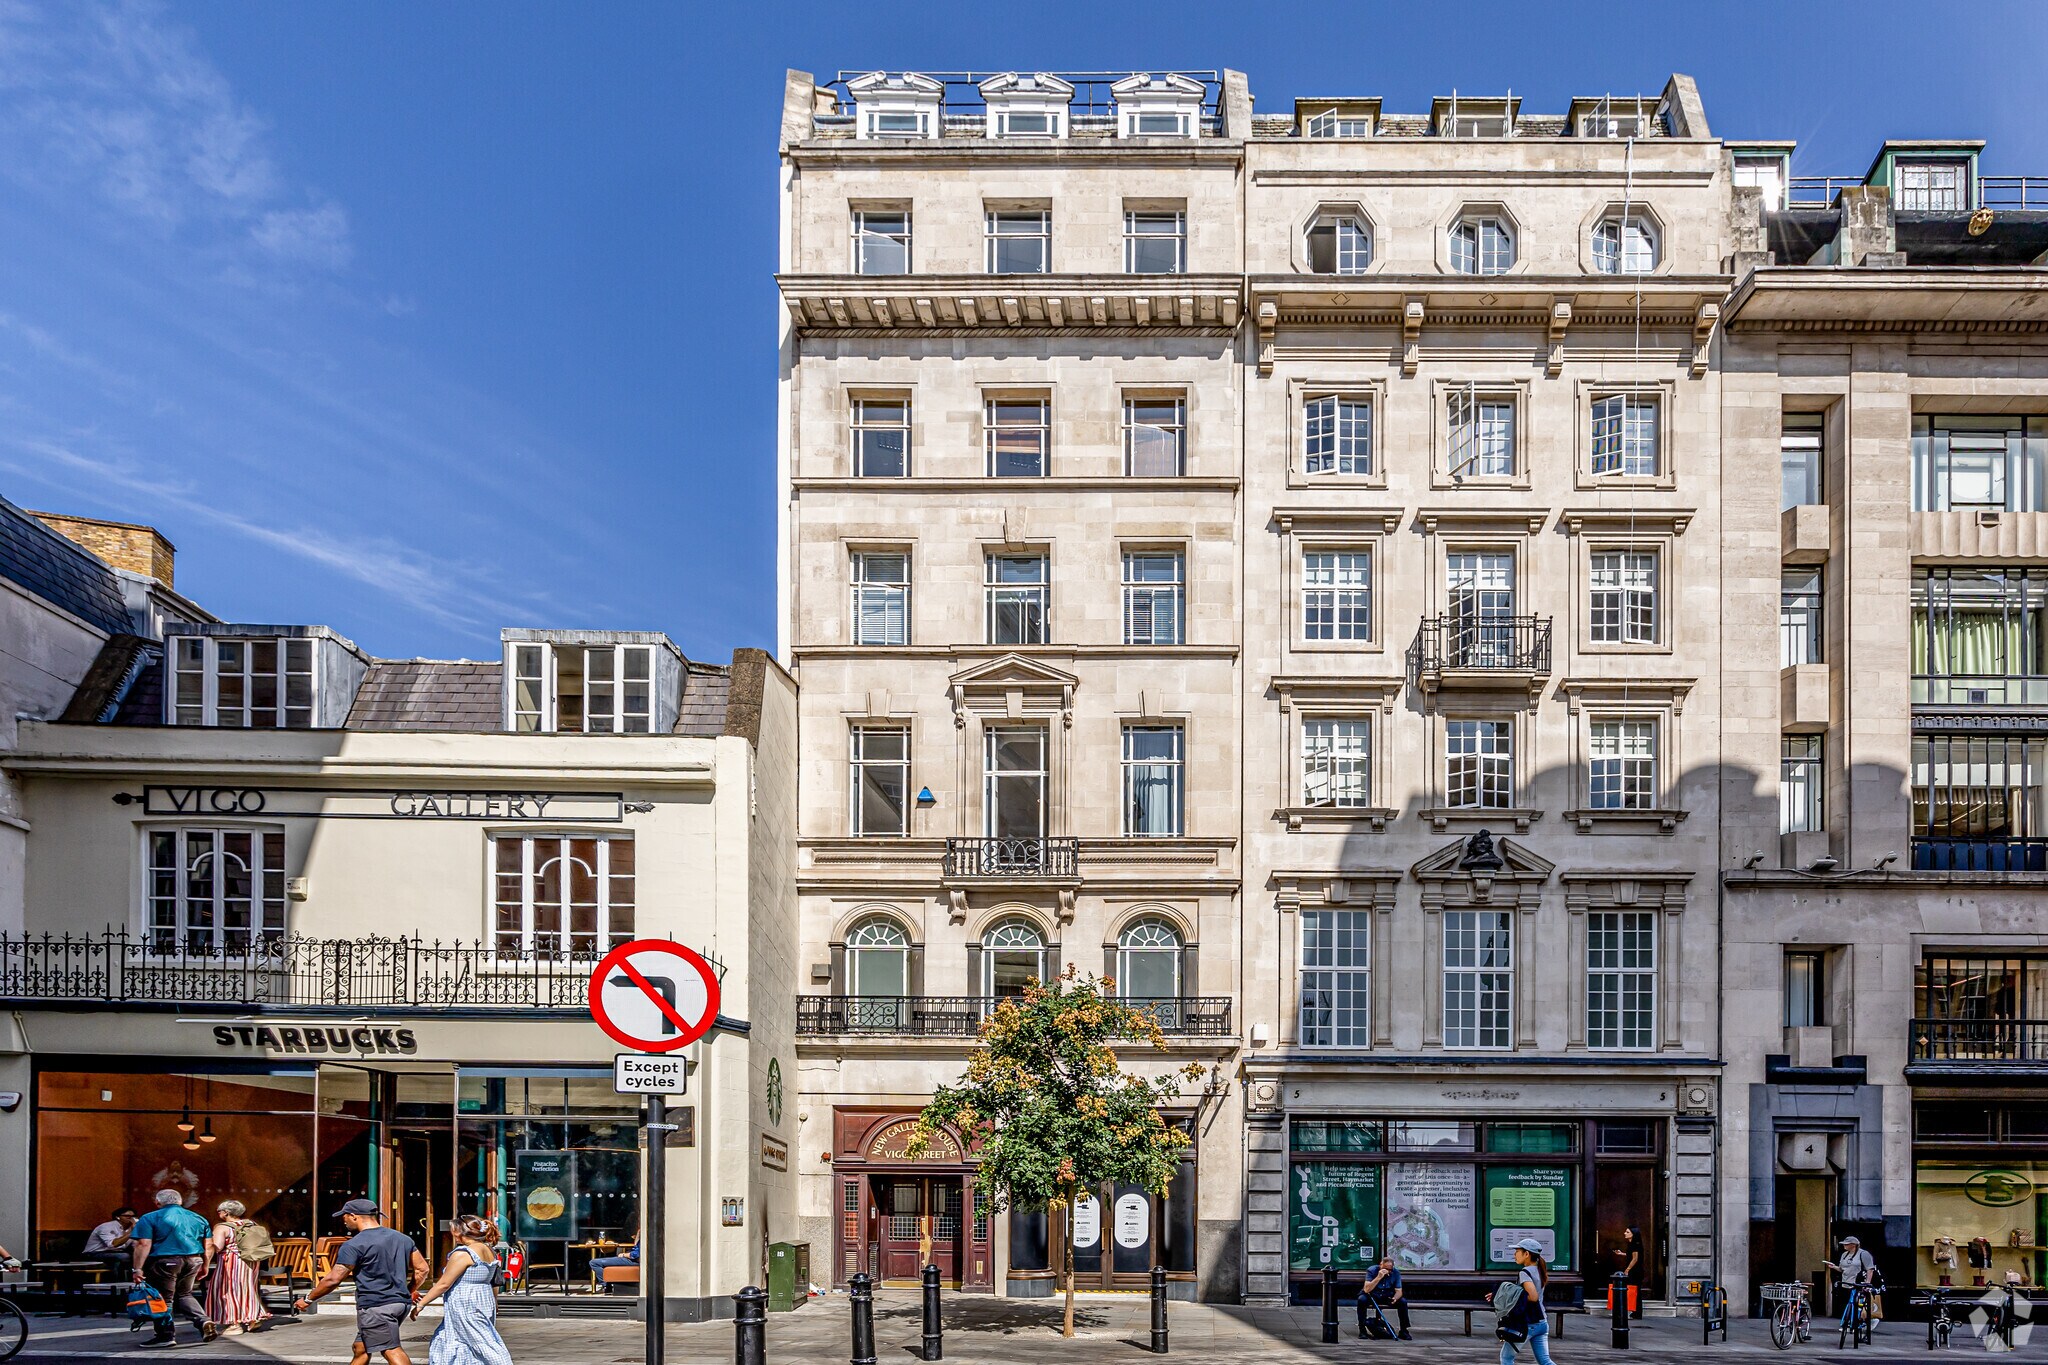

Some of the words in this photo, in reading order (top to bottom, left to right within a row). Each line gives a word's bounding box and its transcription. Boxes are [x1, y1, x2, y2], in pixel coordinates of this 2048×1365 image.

[166, 789, 265, 812] VIGO
[391, 792, 553, 817] GALLERY
[213, 1025, 416, 1051] STARBUCKS
[624, 1060, 679, 1075] Except
[625, 1076, 675, 1088] cycles
[1294, 1089, 1300, 1099] 5
[1660, 1092, 1666, 1101] 5
[872, 1135, 888, 1156] NEW
[933, 1127, 960, 1158] HOUSE
[1804, 1144, 1814, 1154] 4
[1690, 1283, 1699, 1292] H
